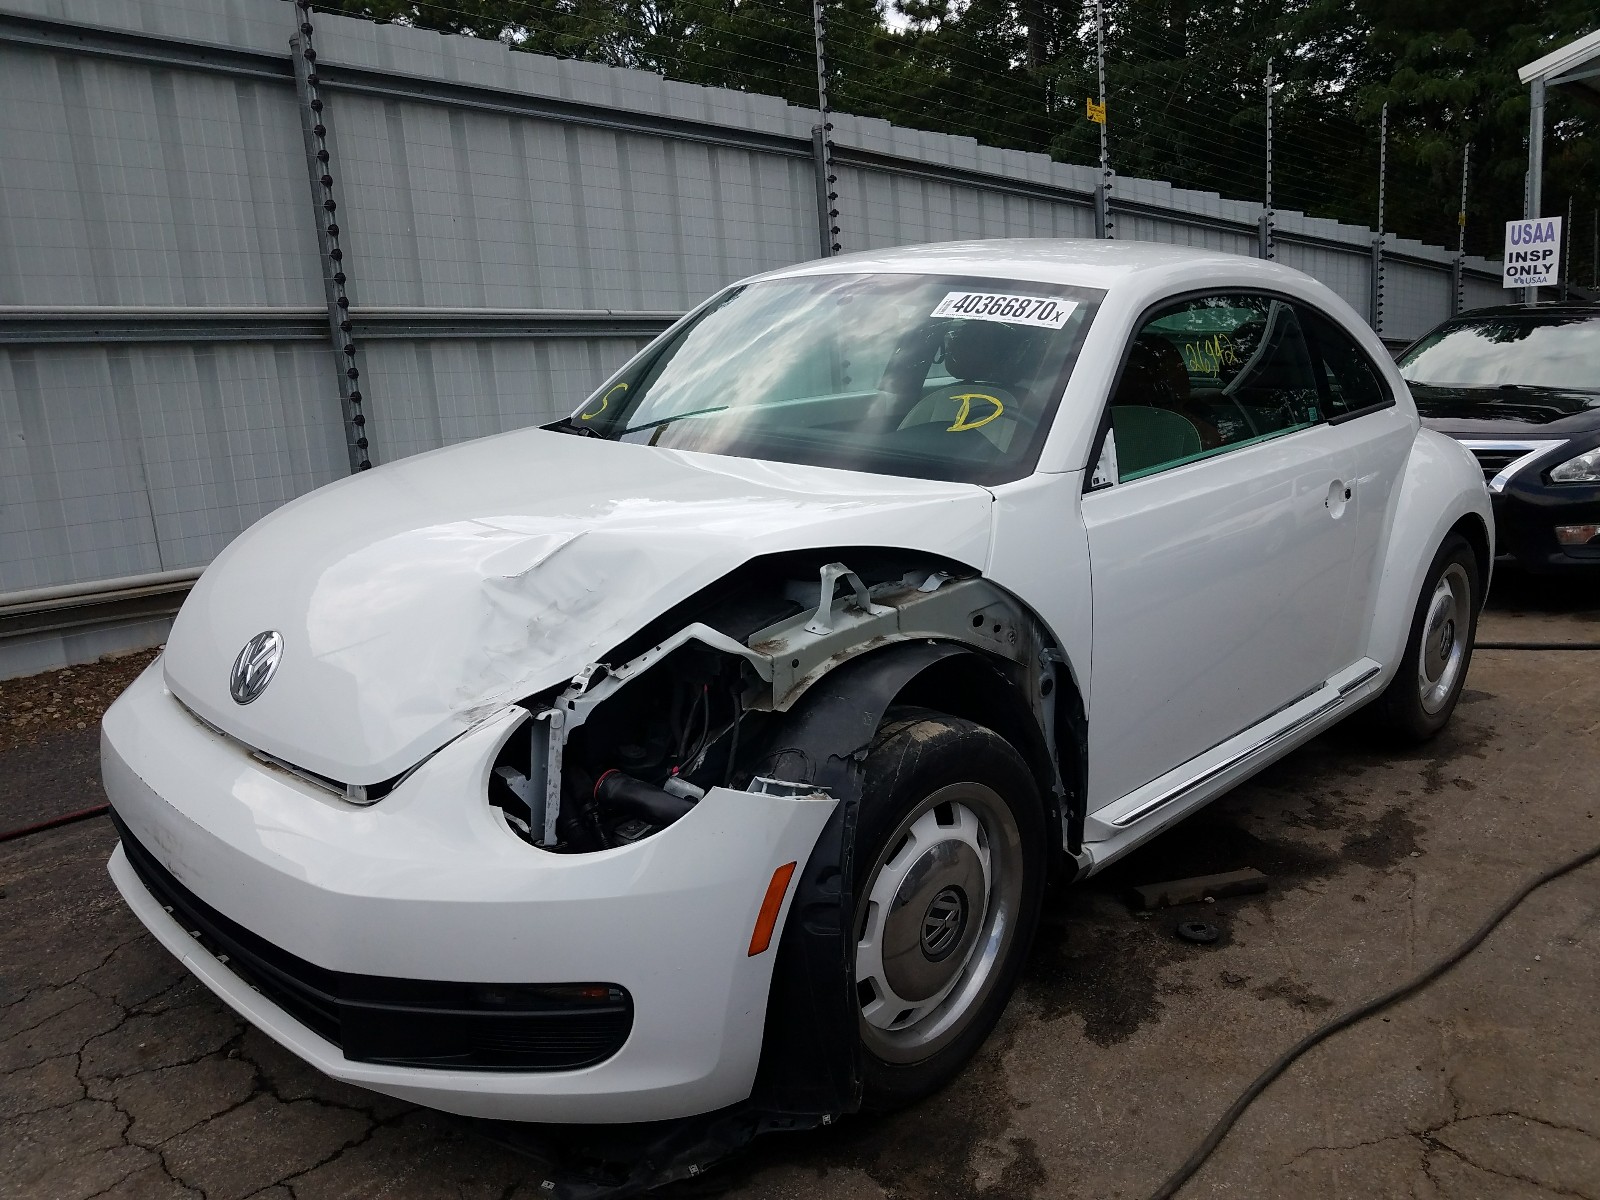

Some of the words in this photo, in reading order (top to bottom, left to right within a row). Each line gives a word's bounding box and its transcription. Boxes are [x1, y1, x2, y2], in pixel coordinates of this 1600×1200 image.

[1510, 222, 1555, 245] USAA
[1508, 249, 1554, 264] INSP
[1506, 263, 1554, 277] ONLY
[1525, 276, 1548, 285] USAA
[581, 382, 629, 420] S
[946, 393, 1004, 432] D
